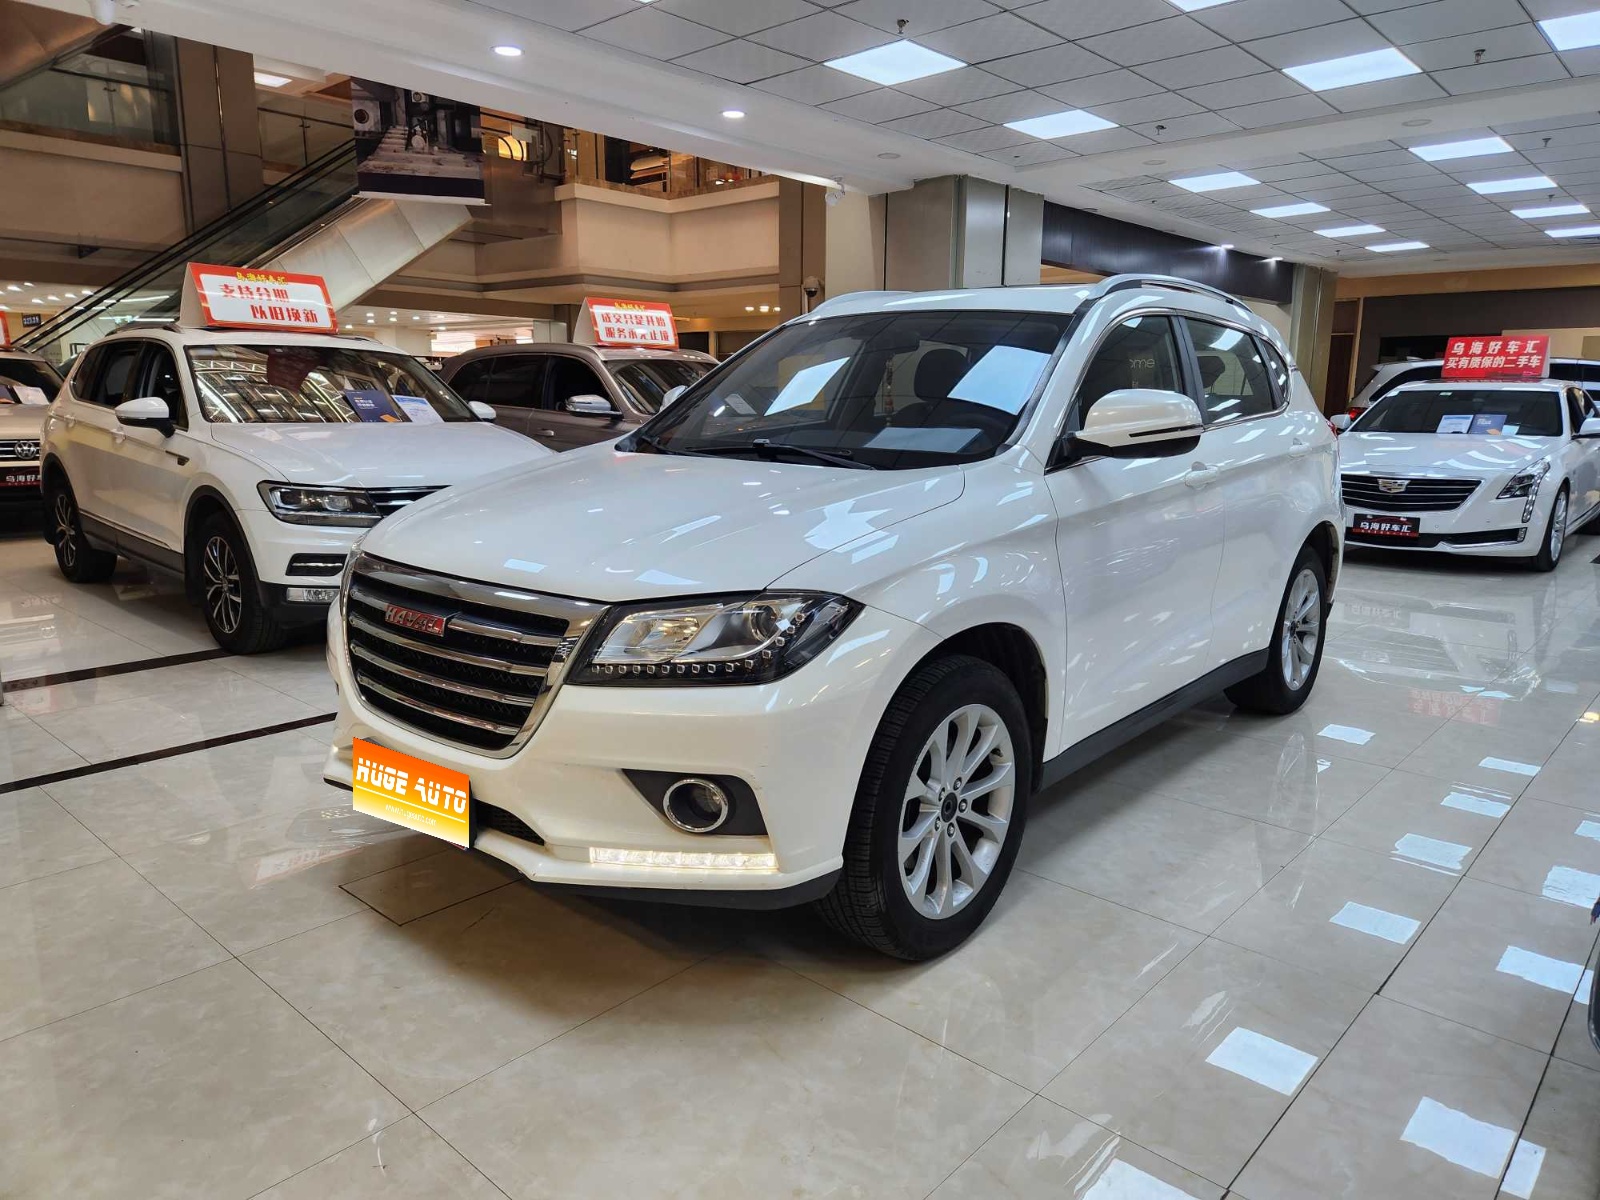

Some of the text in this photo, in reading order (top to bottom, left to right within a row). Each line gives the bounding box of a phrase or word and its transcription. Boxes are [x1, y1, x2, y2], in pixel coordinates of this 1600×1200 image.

[250, 304, 318, 323] 以旧换新
[601, 312, 666, 327] 成交只是开始
[1451, 340, 1540, 355] 乌海好车汇
[1445, 355, 1542, 369] 买有质保的二手车
[1360, 521, 1413, 533] 乌海好车汇
